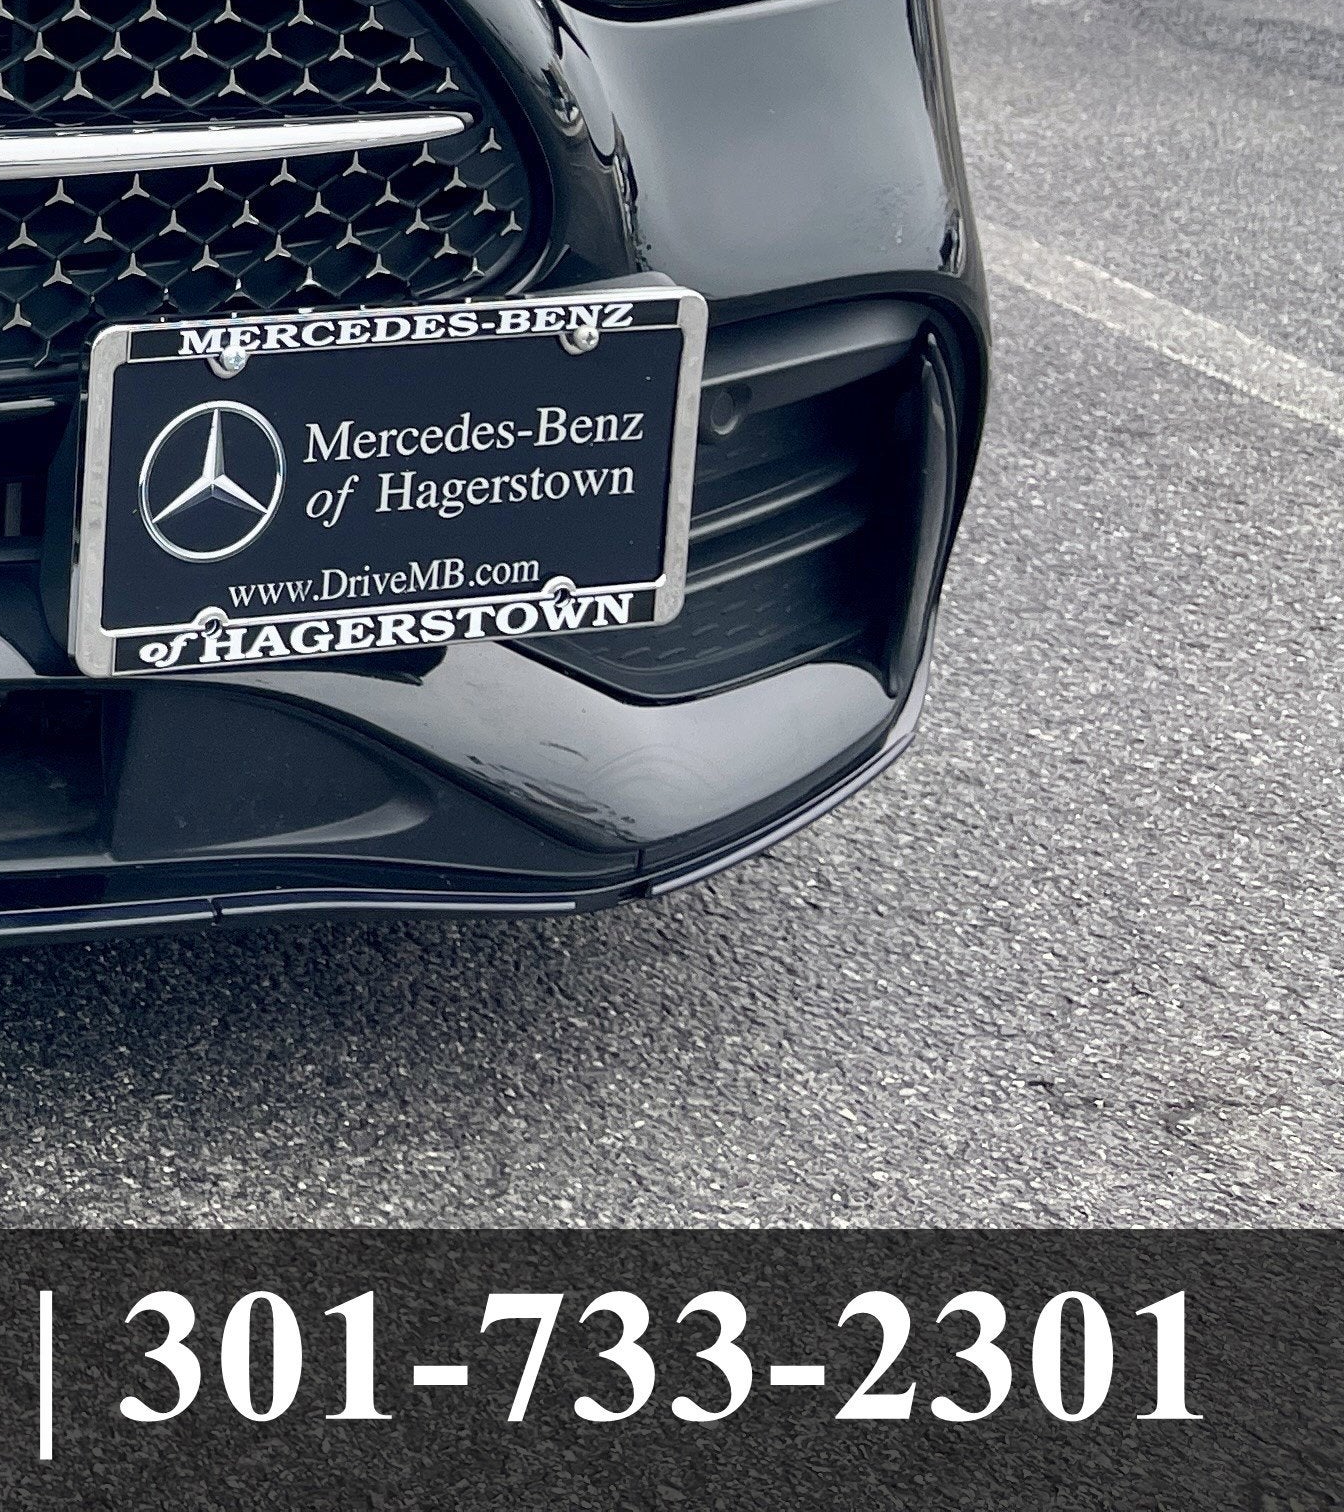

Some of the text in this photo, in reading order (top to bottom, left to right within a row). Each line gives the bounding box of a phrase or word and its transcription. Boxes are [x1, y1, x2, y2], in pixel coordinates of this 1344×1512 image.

[178, 301, 634, 356] MERCEDES-BENZ
[303, 406, 645, 463] Mercedes-Benz
[305, 465, 636, 528] of Hagerstown
[228, 558, 540, 609] www.DriveMB.com
[138, 592, 634, 668] of HAGERSTOWN
